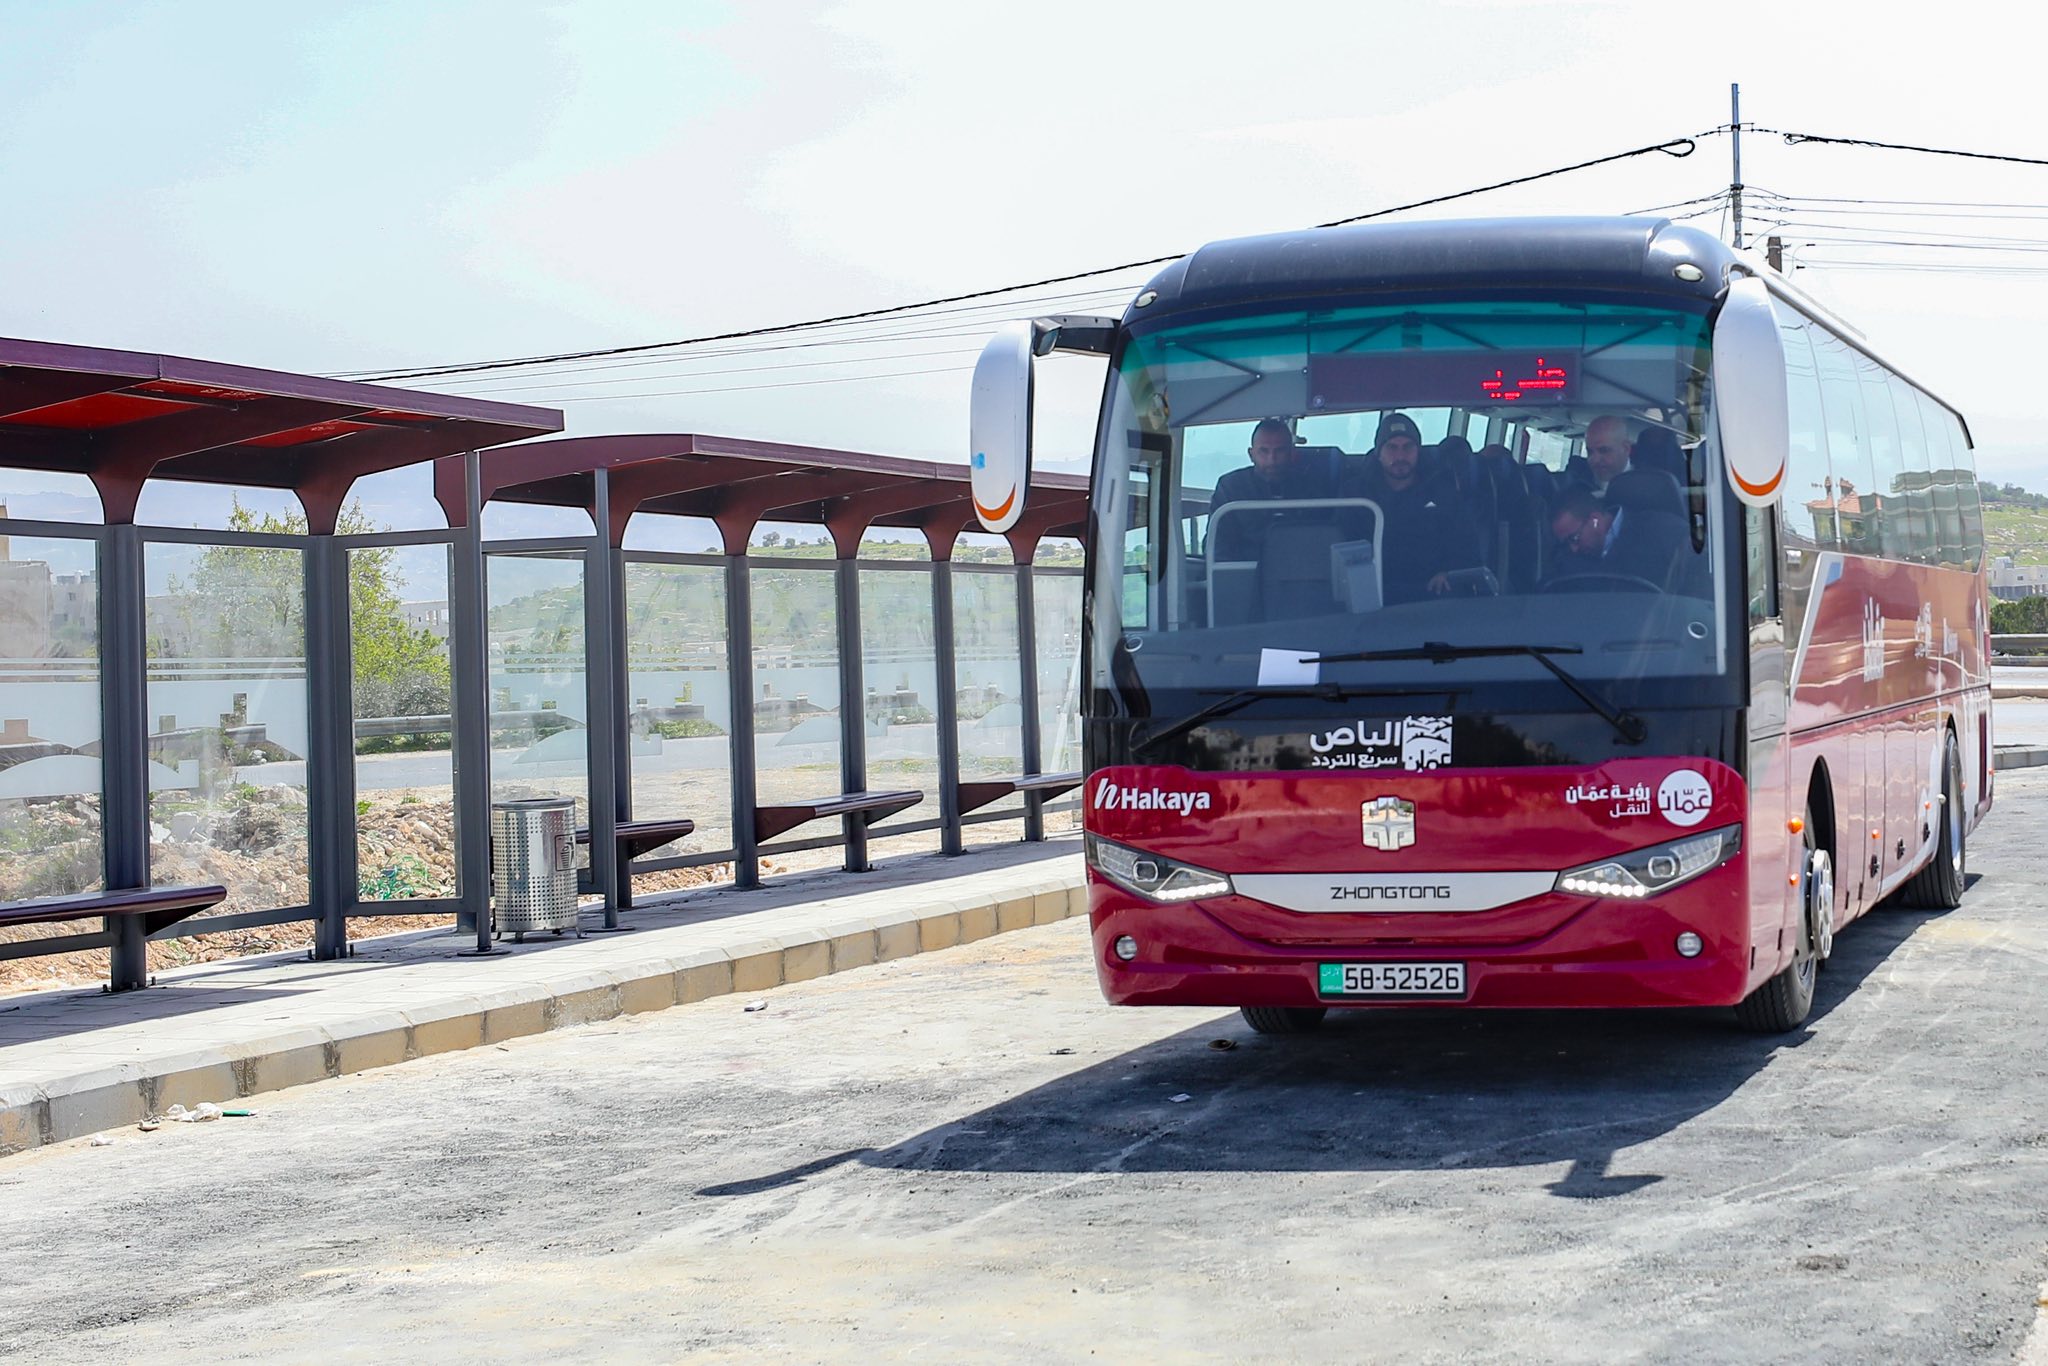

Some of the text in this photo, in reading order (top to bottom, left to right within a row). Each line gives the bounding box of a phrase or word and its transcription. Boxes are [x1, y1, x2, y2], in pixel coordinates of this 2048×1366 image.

[1310, 720, 1402, 752] الباص
[1311, 753, 1398, 769] سريع التردد
[1121, 787, 1211, 816] Hakaya
[1611, 782, 1650, 802] رؤية
[1609, 801, 1651, 818] للنقل
[1330, 886, 1450, 900] ZHONGTONG
[1345, 967, 1459, 990] 58-52526
